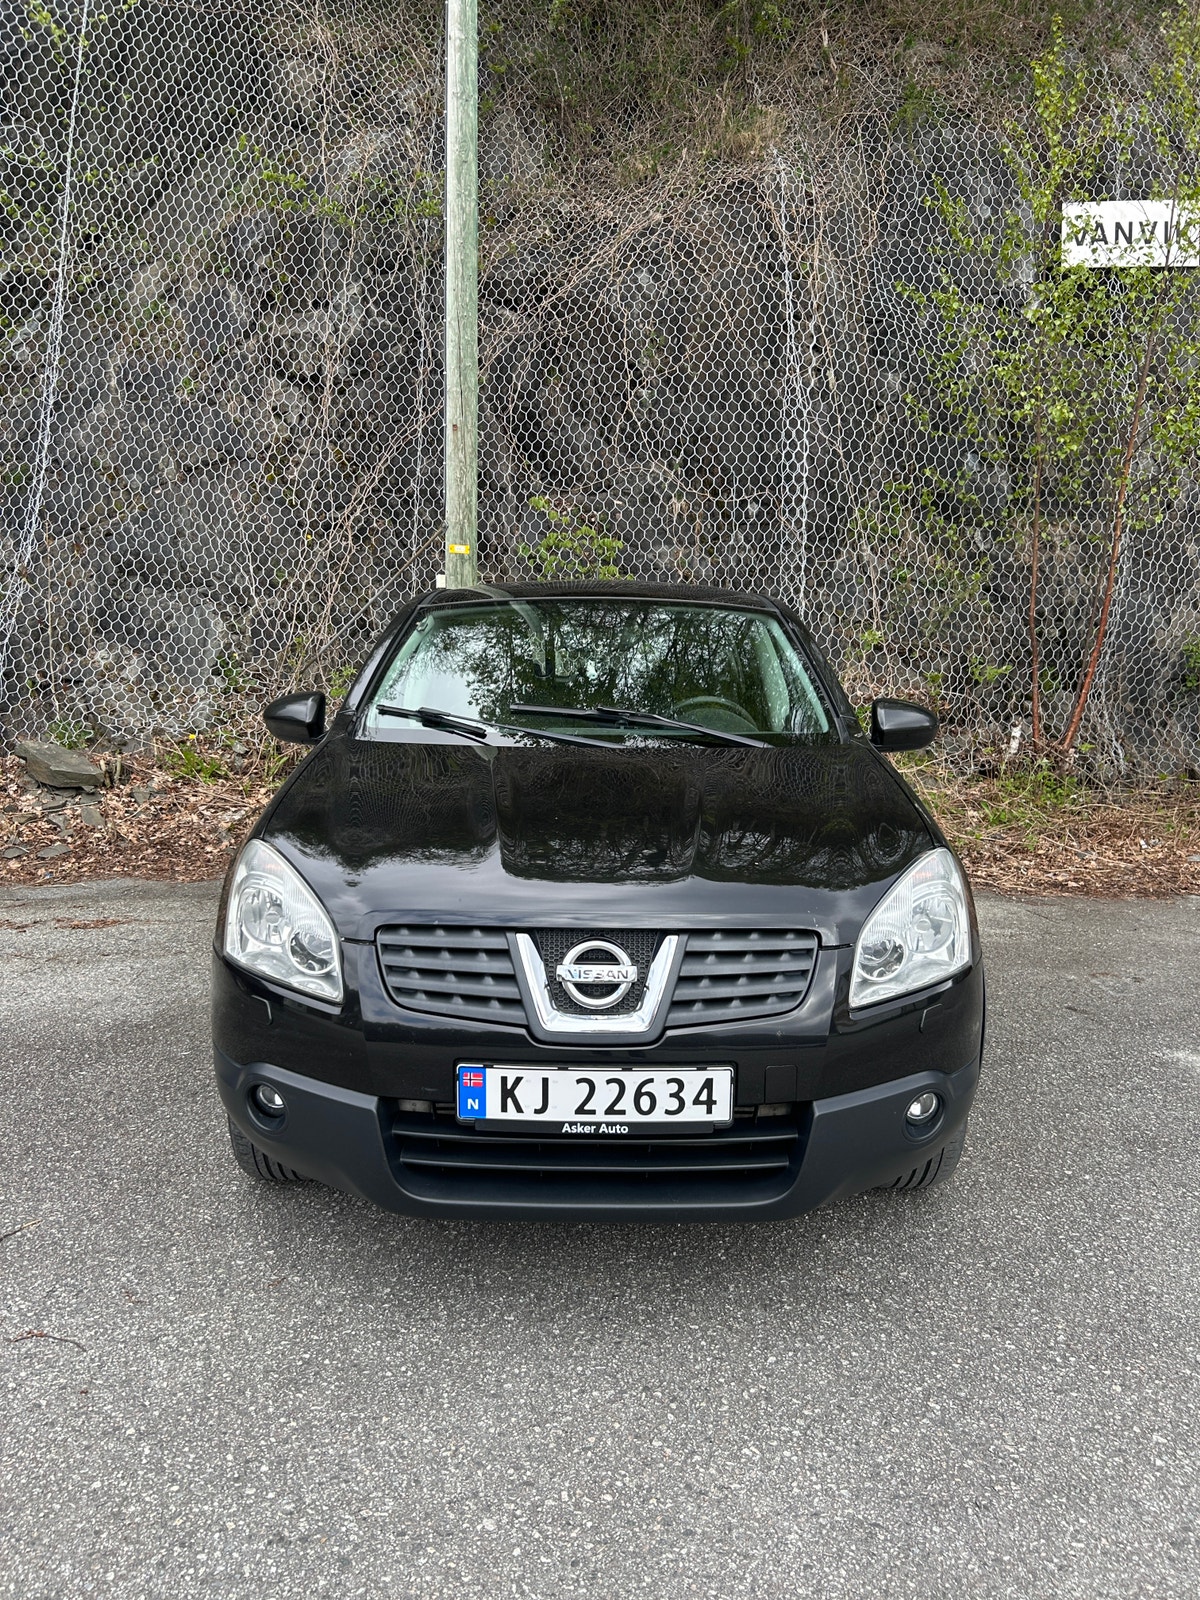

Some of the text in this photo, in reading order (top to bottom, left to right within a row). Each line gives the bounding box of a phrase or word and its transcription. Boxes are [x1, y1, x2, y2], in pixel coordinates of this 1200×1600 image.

[565, 968, 629, 980] NISSAN
[500, 1075, 717, 1116] KJ 22634
[467, 1098, 479, 1110] N
[562, 1123, 629, 1134] Asker Auto
